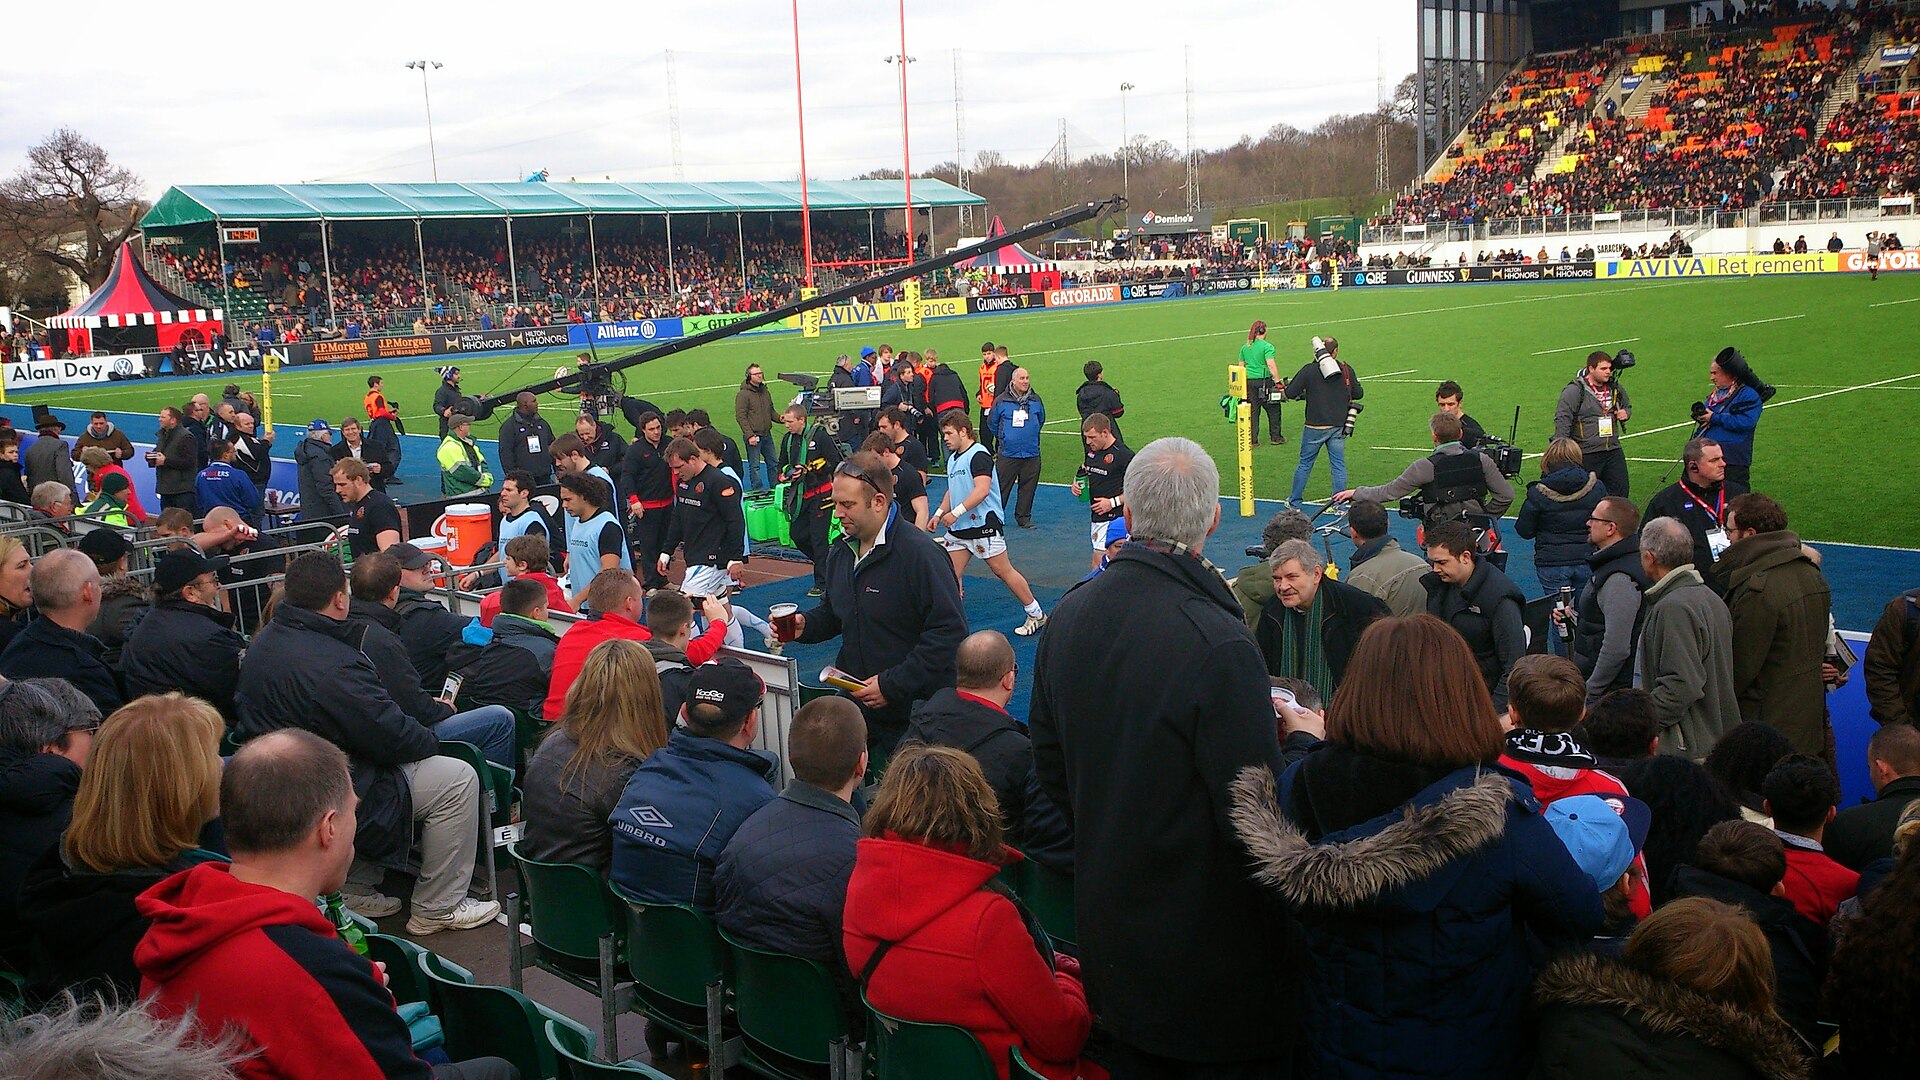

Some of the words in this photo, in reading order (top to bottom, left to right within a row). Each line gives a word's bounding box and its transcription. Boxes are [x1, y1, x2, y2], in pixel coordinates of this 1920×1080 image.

[1154, 213, 1194, 223] Domino's
[230, 230, 256, 239] 14:50
[1629, 259, 1706, 276] AVIVA
[1718, 258, 1826, 273] Retrement
[1366, 271, 1387, 284] QBE
[1406, 270, 1455, 283] GUINNESS
[1131, 285, 1148, 297] QBE
[1217, 281, 1237, 289] ROVER
[1050, 287, 1114, 306] GATORADE
[912, 293, 921, 326] AVIVA
[977, 297, 1017, 312] GUINNESS
[819, 304, 879, 326] AVIVA
[525, 329, 547, 338] HILTON
[597, 325, 640, 339] Allianz
[378, 337, 432, 349] J.P.Morgan
[462, 339, 507, 350] HHONORS
[526, 334, 568, 345] HHONORS
[312, 342, 368, 353] J.P.Morgan
[12, 363, 56, 381] Alan
[64, 362, 102, 380] Day
[501, 830, 512, 840] E
[617, 820, 667, 847] UMBRO
